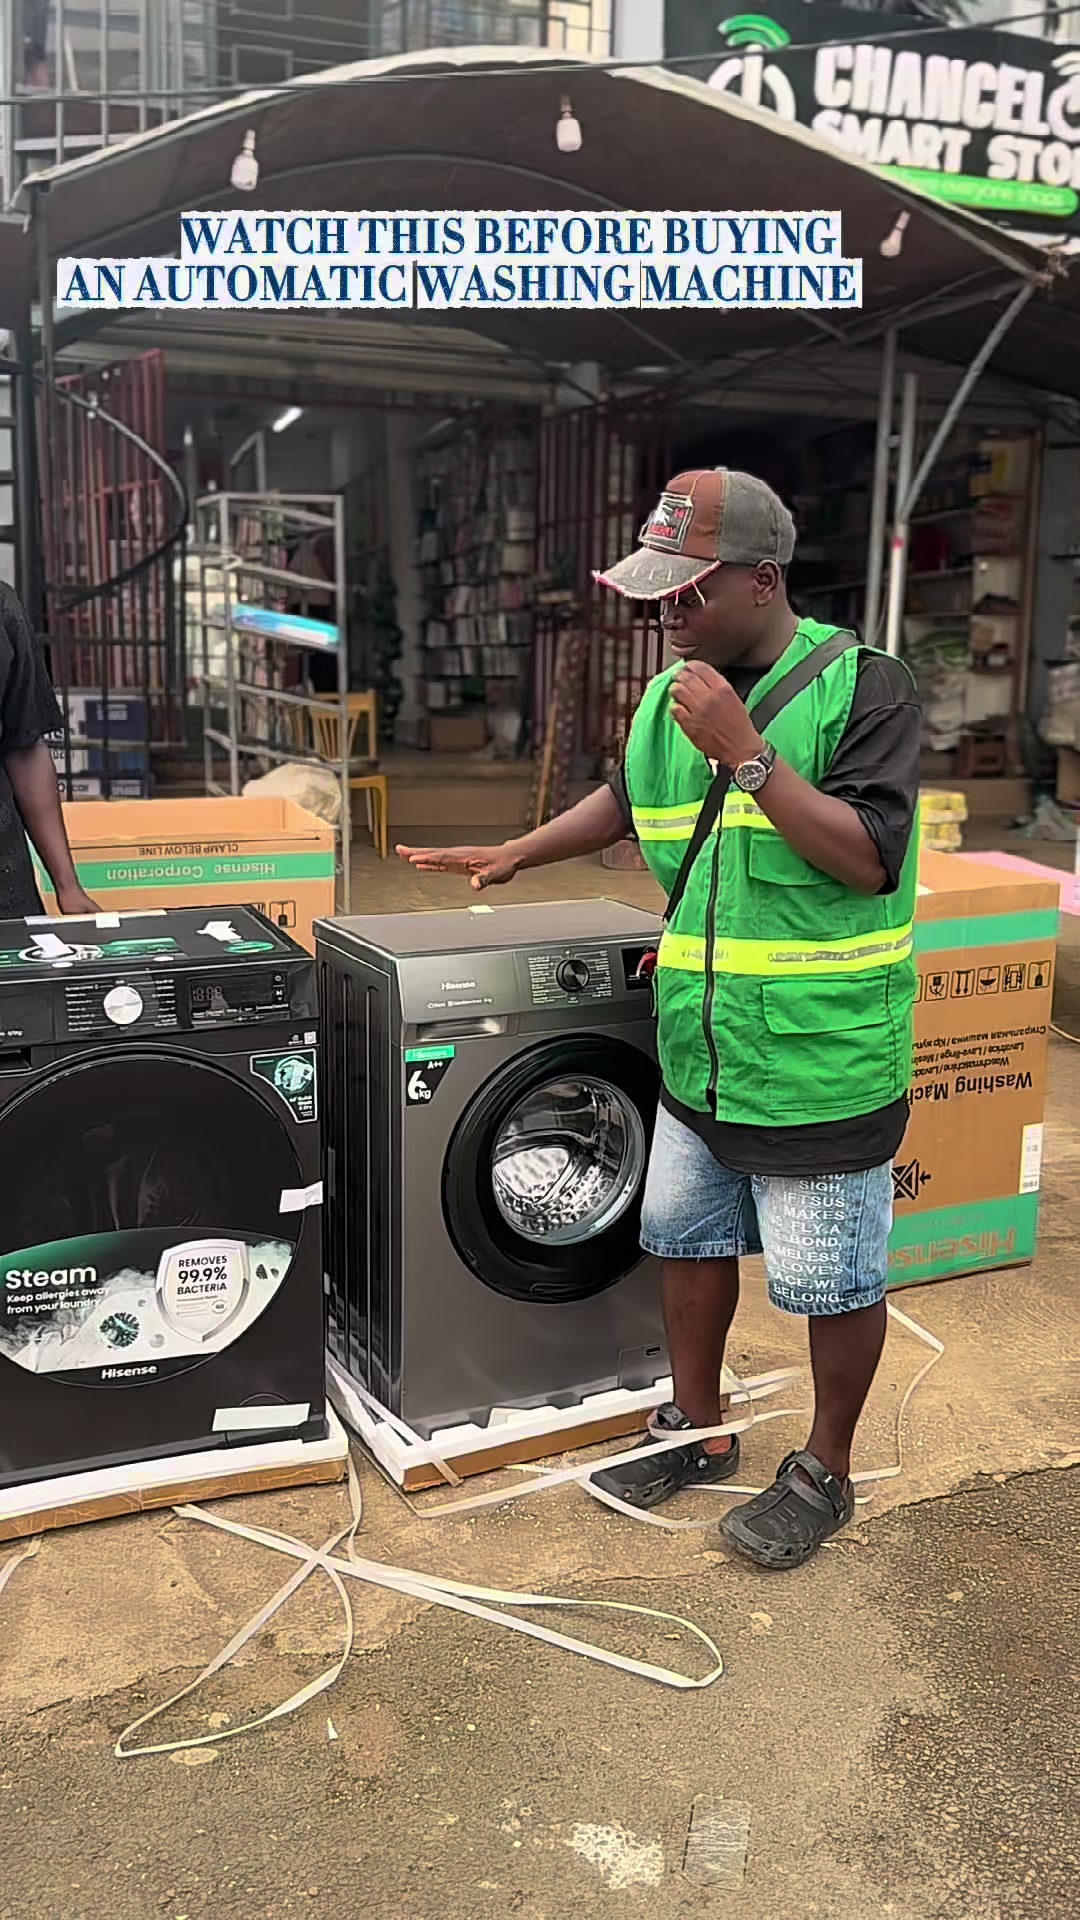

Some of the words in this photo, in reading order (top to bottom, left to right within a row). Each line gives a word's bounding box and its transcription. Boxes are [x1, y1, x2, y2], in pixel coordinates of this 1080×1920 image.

[811, 109, 971, 174] SMART
[138, 846, 163, 856] LINE
[166, 844, 203, 855] BELOW
[203, 843, 239, 854] CLAMP
[106, 864, 205, 882] Corporation
[213, 862, 276, 876] Hisense
[427, 1061, 444, 1070] A++
[954, 1071, 1033, 1094] Washing
[783, 1205, 845, 1221] MAKES
[178, 1255, 228, 1268] REMOVES
[5, 1266, 97, 1290] Steam
[178, 1266, 228, 1284] 99.9%
[7, 1294, 34, 1304] Keep
[35, 1288, 80, 1301] allergies
[81, 1286, 111, 1297] away
[177, 1282, 227, 1295] BACTERIA
[7, 1304, 33, 1314] from
[35, 1303, 60, 1314] your
[60, 1298, 101, 1310] laundry
[101, 1365, 158, 1380] Hisense
